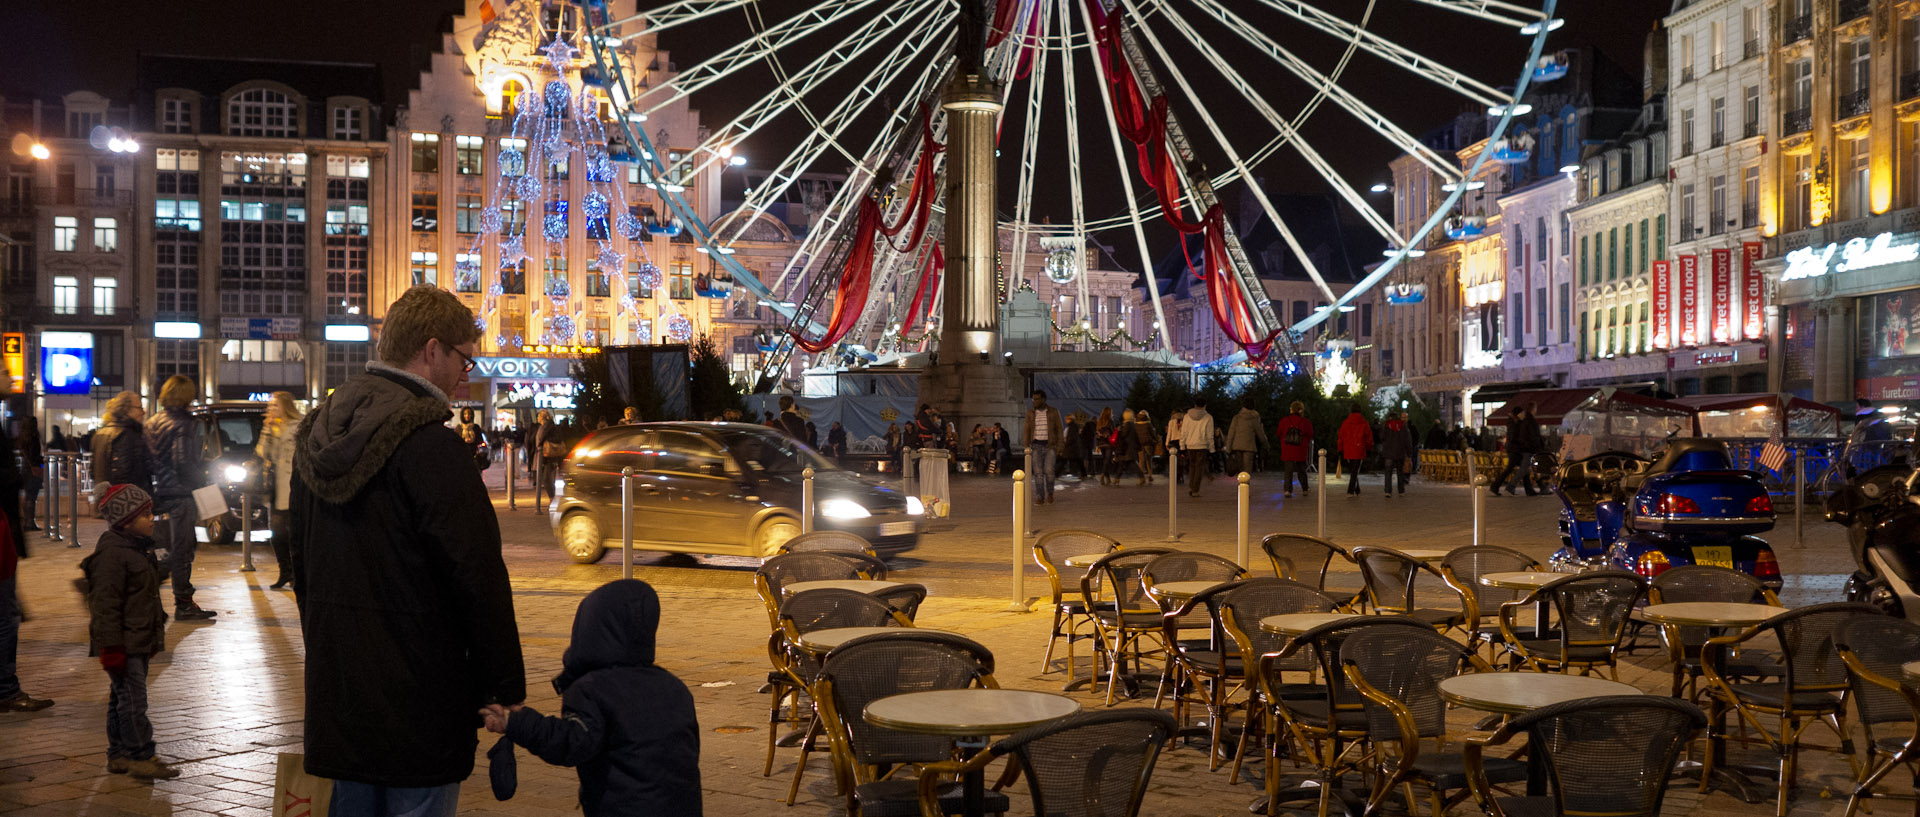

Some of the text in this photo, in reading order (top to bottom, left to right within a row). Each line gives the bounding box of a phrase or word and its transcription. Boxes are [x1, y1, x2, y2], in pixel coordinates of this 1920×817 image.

[1683, 258, 1694, 287] nord
[1716, 252, 1728, 282] nord
[1656, 264, 1667, 292] nord
[1716, 284, 1728, 302] du
[1747, 279, 1759, 297] du
[1656, 294, 1667, 311] du
[1683, 289, 1694, 306] du
[52, 354, 82, 387] P
[477, 358, 549, 376] VOIX
[1882, 386, 1920, 399] furet.com
